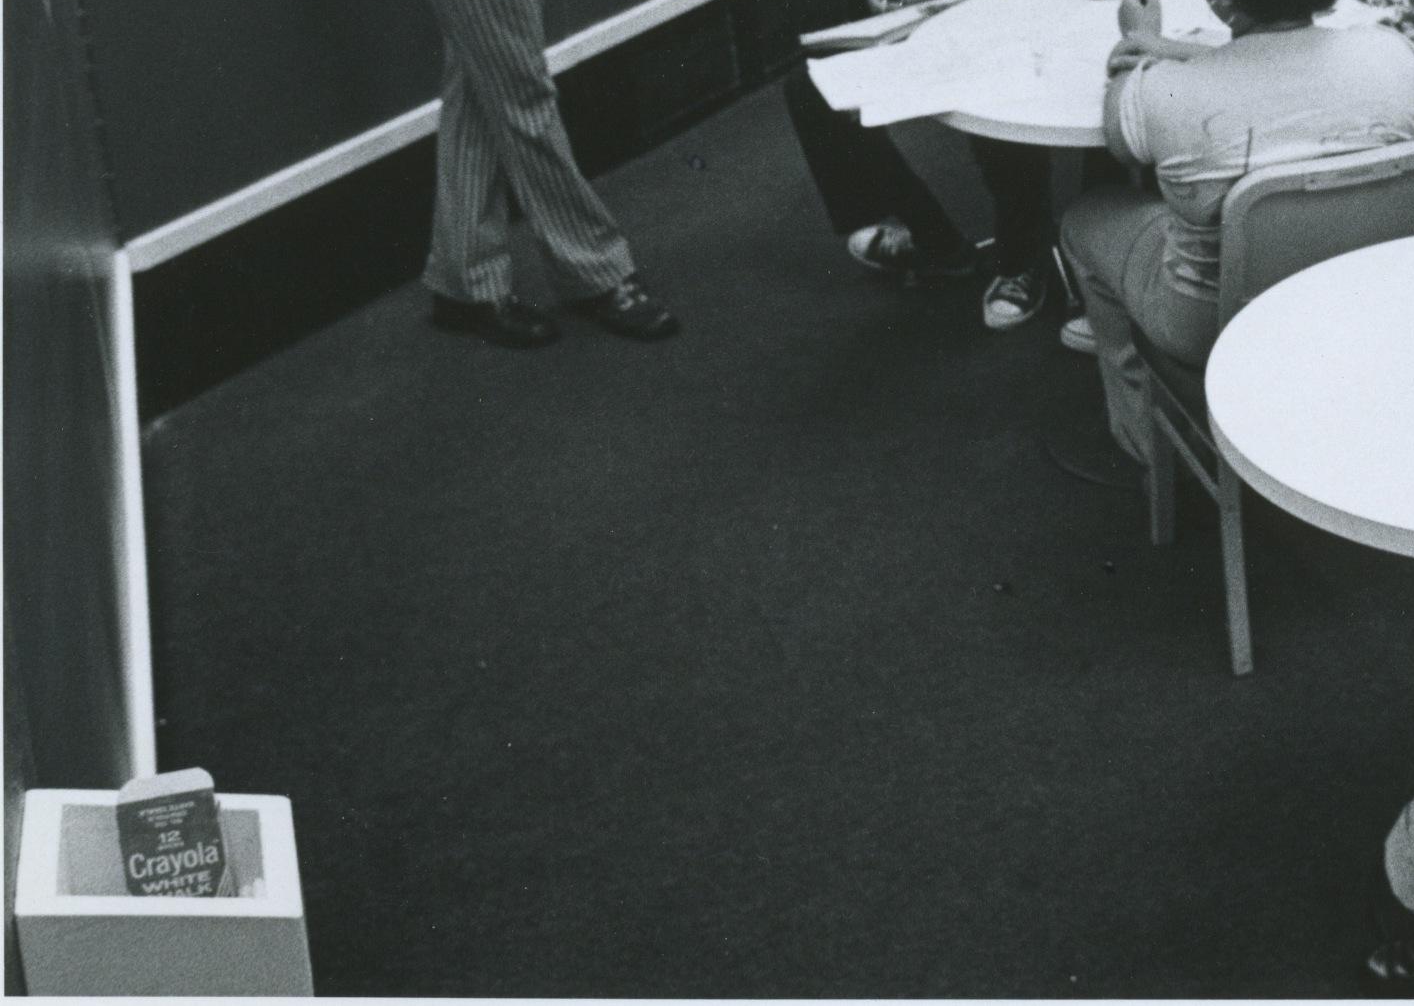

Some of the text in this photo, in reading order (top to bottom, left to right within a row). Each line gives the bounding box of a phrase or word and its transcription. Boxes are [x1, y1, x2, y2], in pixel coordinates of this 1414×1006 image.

[159, 830, 181, 844] 12
[129, 841, 219, 879] Crayola
[141, 870, 212, 893] WHITE
